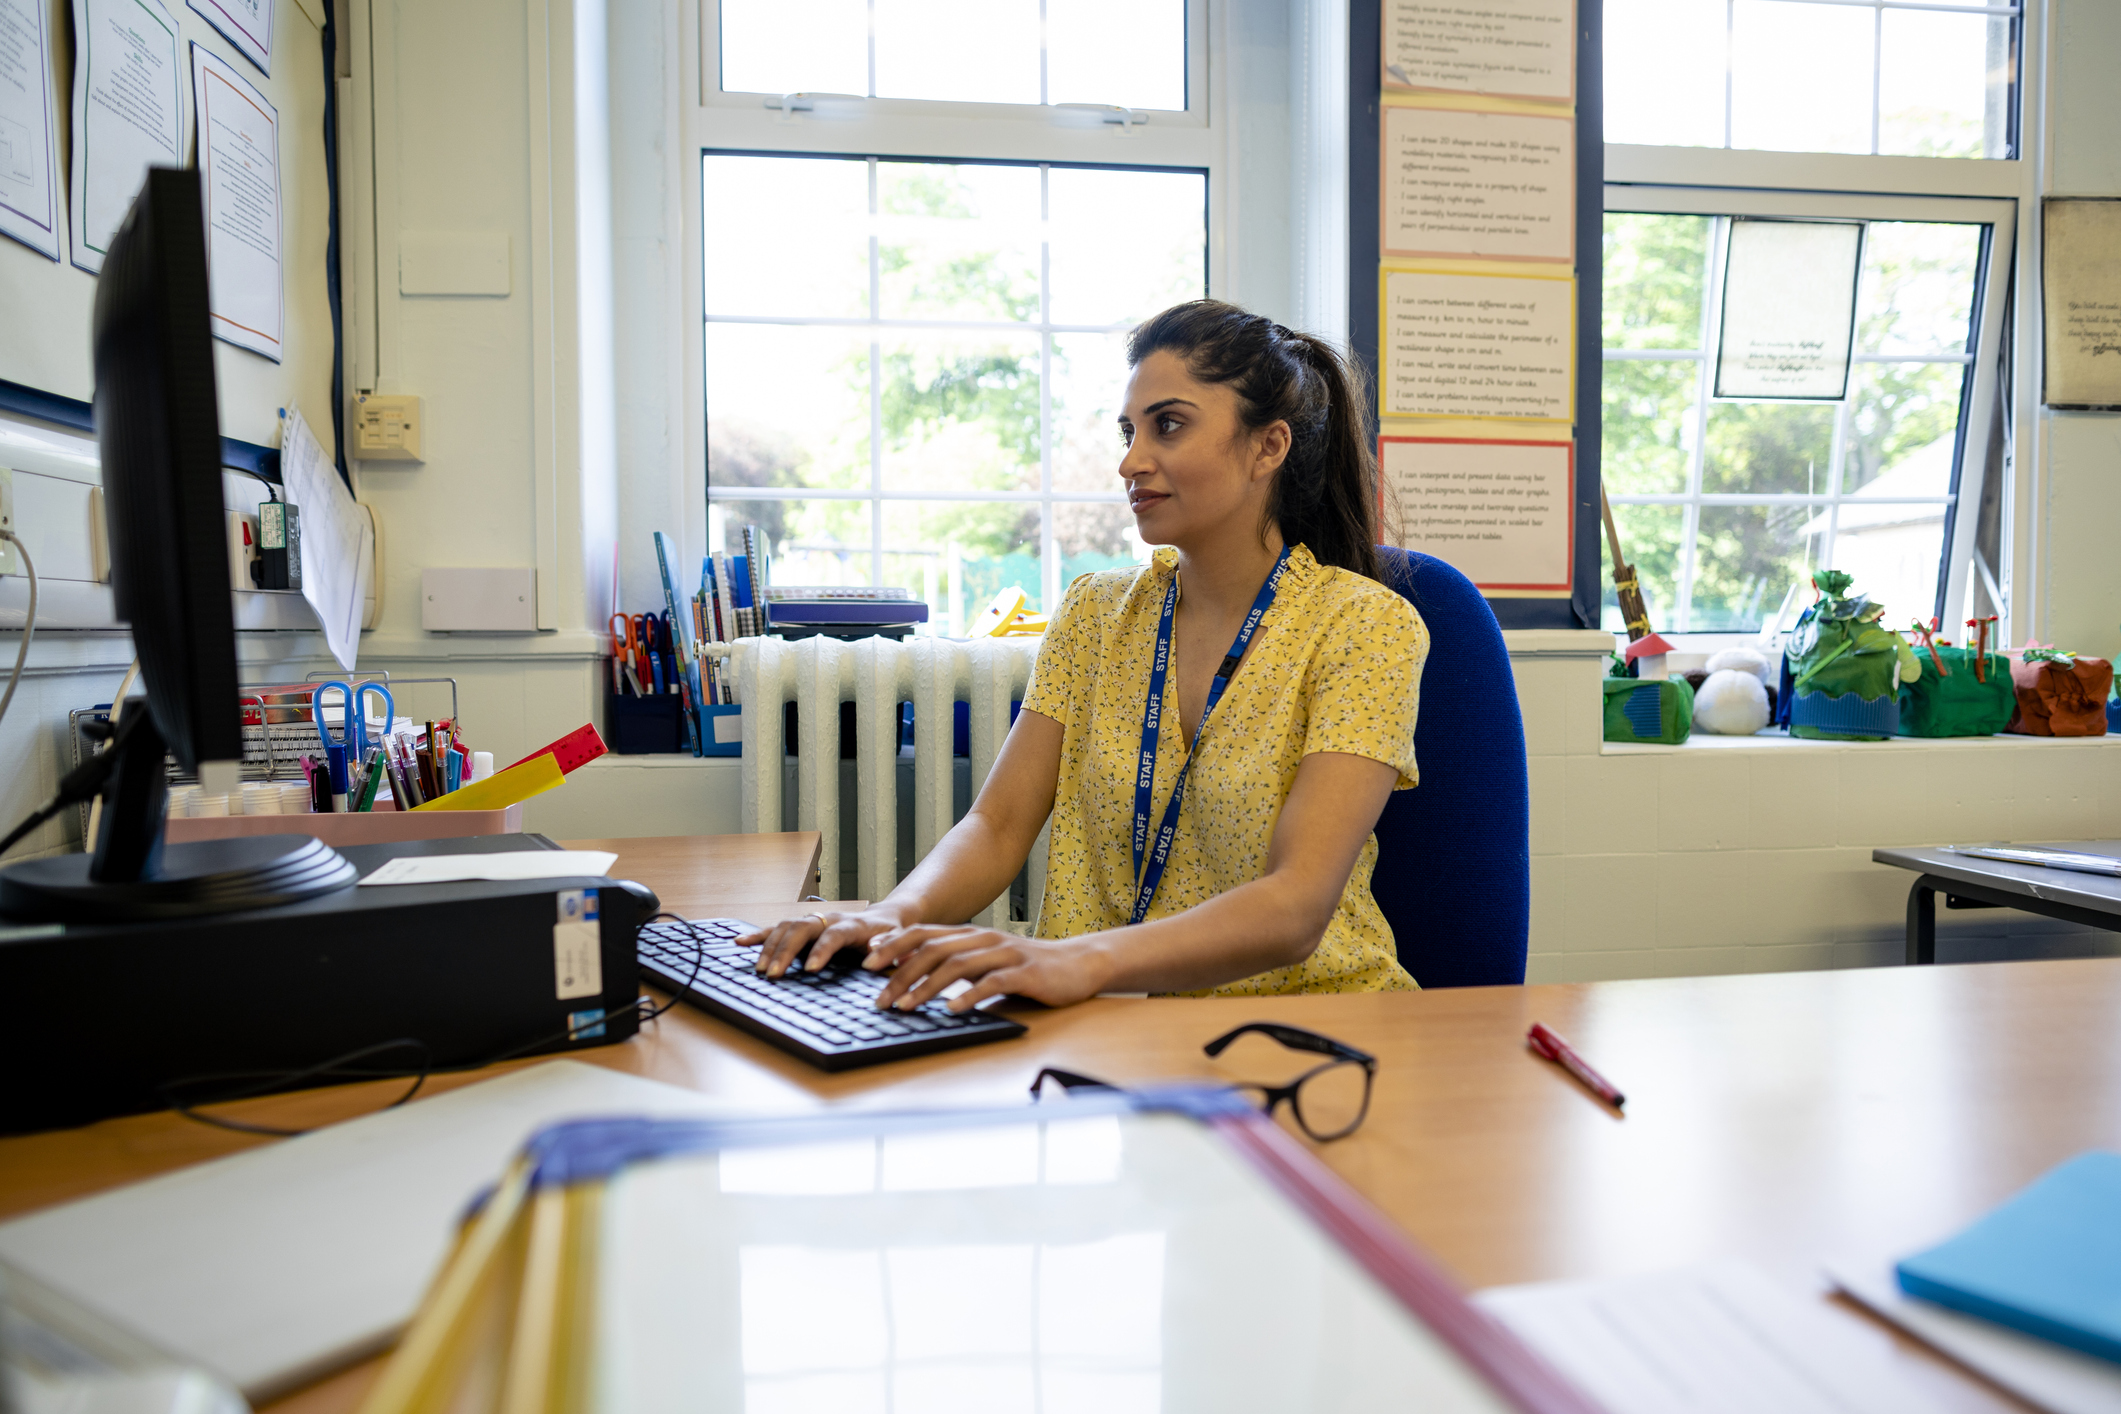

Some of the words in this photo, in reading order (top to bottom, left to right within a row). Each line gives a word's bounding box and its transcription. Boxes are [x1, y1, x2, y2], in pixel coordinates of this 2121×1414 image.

[1446, 299, 1475, 307] between
[1477, 300, 1507, 310] different
[1443, 314, 1454, 322] km
[1477, 316, 1494, 324] hour
[1498, 333, 1509, 341] the
[1396, 344, 1432, 352] rectilinear
[1434, 345, 1455, 354] shape
[1518, 365, 1547, 373] between
[1396, 375, 1415, 384] logue
[1434, 376, 1456, 385] digital
[1485, 377, 1494, 385] 24
[1496, 378, 1513, 386] hour
[1416, 391, 1435, 399] solve
[1470, 394, 1503, 403] involving
[1505, 396, 1542, 405] converting
[1543, 396, 1560, 405] from
[1419, 472, 1449, 480] interpret
[1467, 473, 1493, 481] present
[1513, 475, 1532, 483] using
[1425, 487, 1465, 496] pictograms,
[1490, 487, 1504, 495] and
[1506, 487, 1523, 495] other
[1517, 505, 1549, 513] questions
[1420, 517, 1462, 526] information
[1424, 533, 1464, 541] pictograms
[1268, 558, 1288, 592] STAFF
[1240, 608, 1262, 643] STAFF
[1156, 638, 1168, 672] STAFF
[1147, 693, 1161, 729] STAFF
[1140, 751, 1154, 788] STAFF
[1135, 813, 1147, 851] STAFF
[1154, 826, 1173, 865] STAFF
